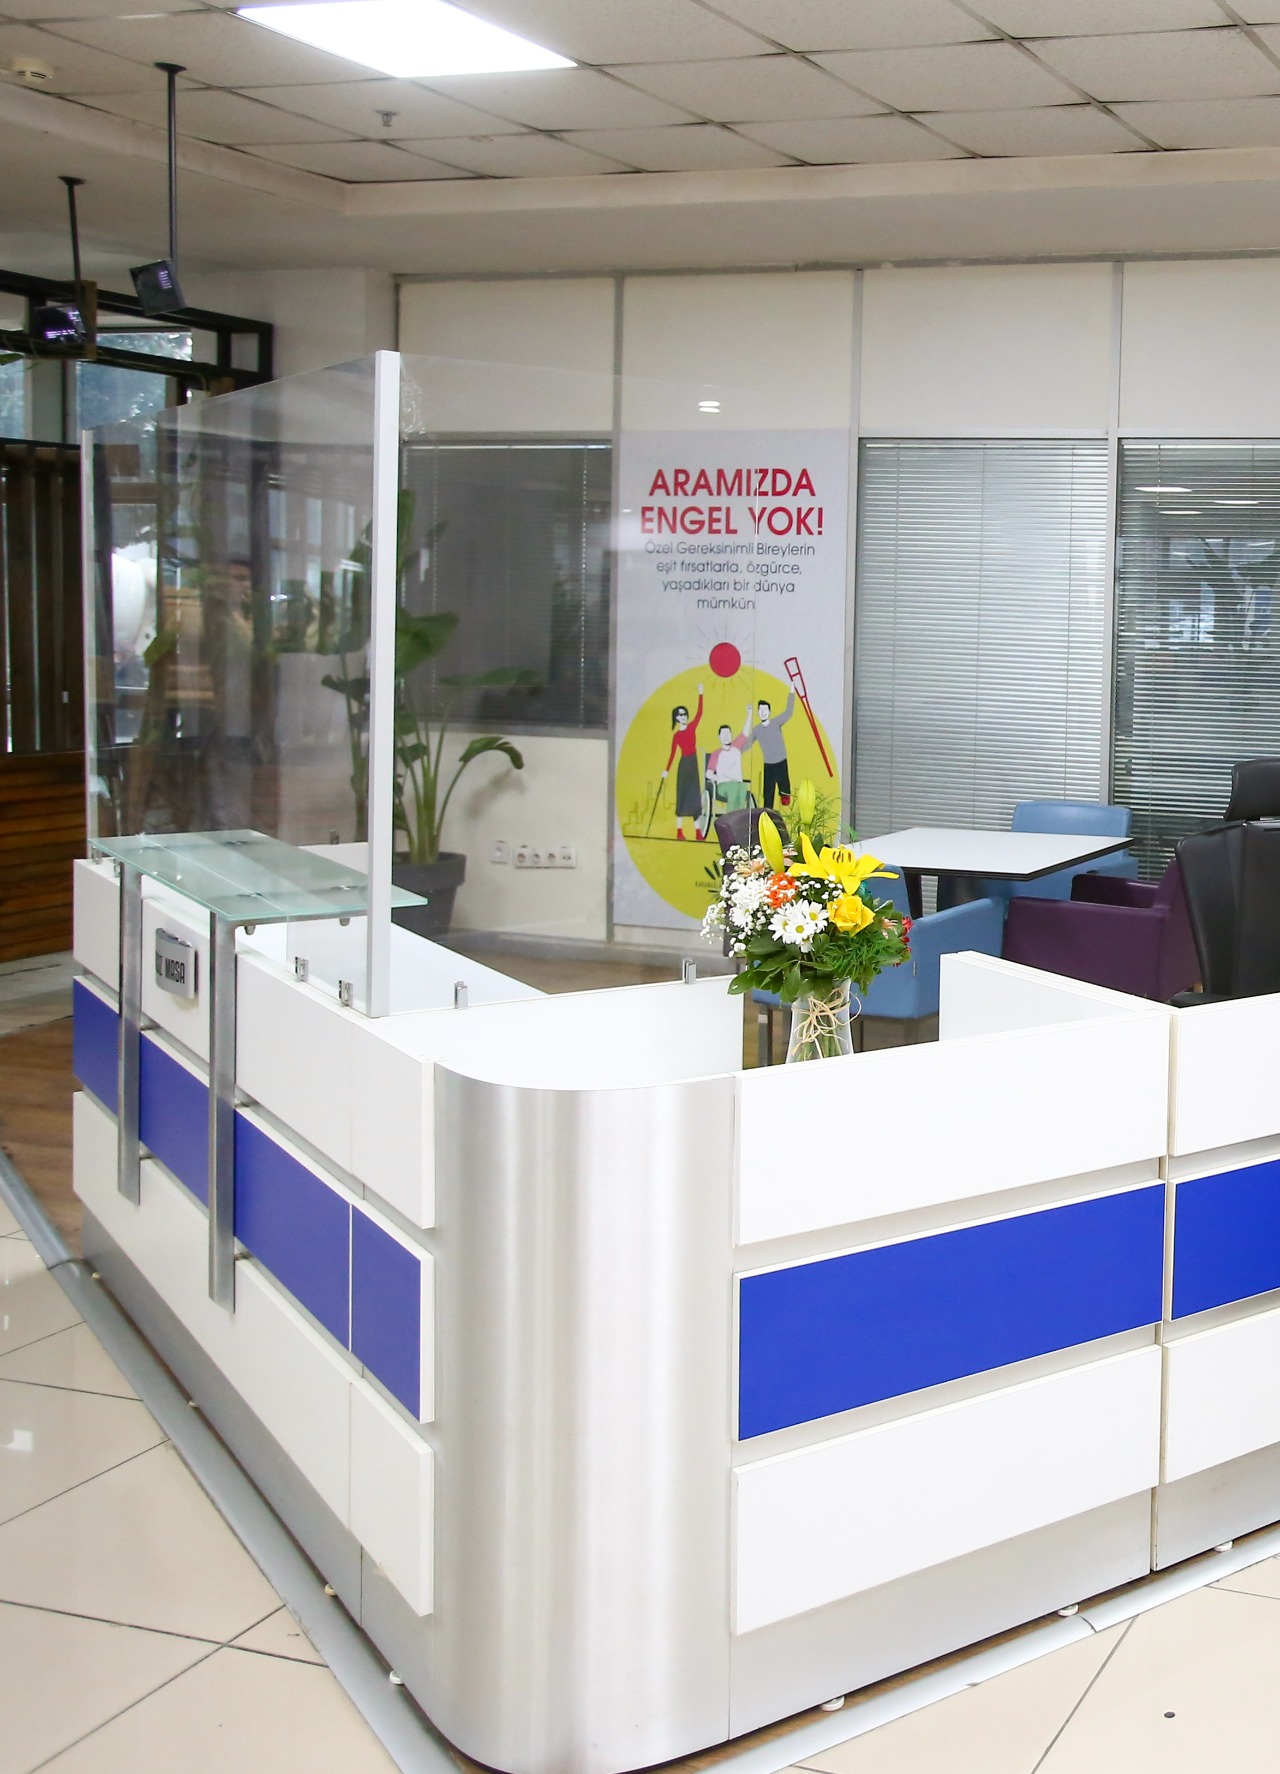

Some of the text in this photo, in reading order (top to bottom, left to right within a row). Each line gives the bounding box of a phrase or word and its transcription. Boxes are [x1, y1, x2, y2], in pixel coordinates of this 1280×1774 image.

[648, 468, 816, 497] ARAMIZDA
[640, 506, 823, 536] ENGEL YOK!
[645, 540, 816, 557] Özel Gereksinimli Bireylerin
[656, 561, 677, 575] eşit
[746, 563, 802, 576] özgürce,
[662, 579, 796, 595] yaşadıkları bir dünya
[165, 958, 186, 985] MASA
